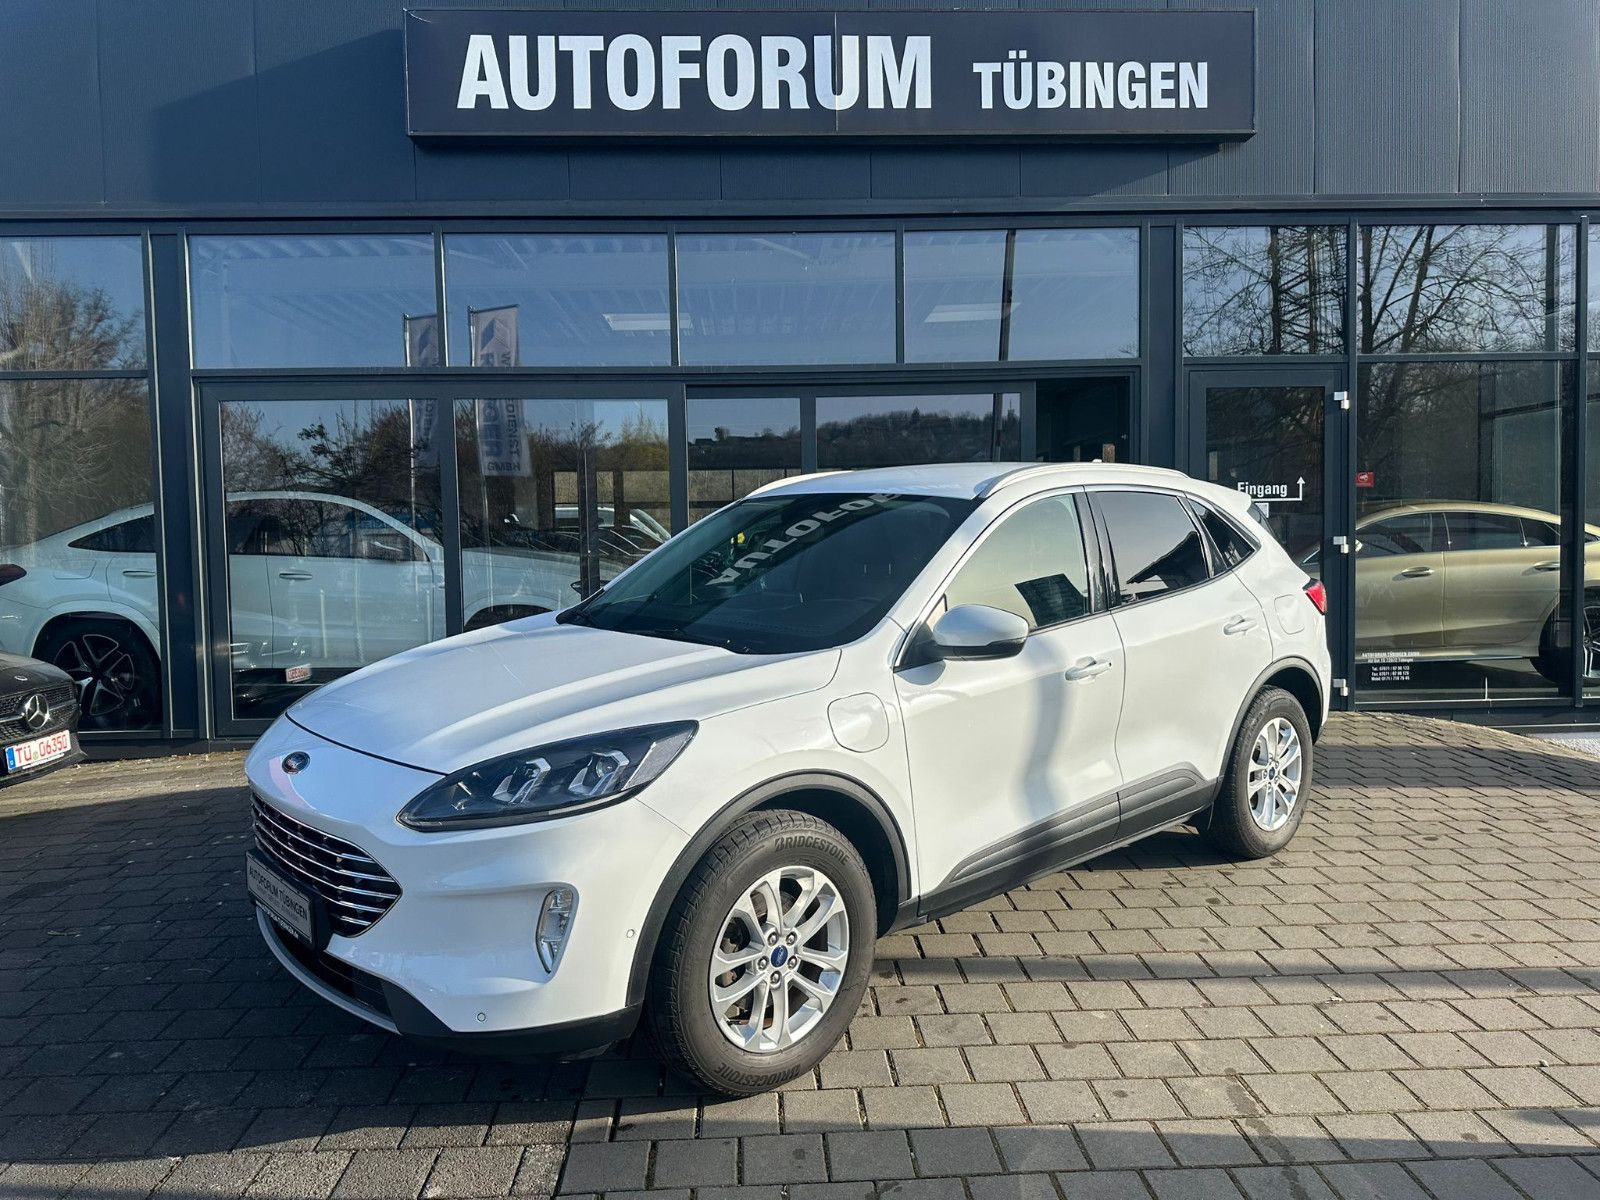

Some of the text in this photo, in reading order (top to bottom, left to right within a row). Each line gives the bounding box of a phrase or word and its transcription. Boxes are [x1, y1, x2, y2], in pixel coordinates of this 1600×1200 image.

[456, 33, 1208, 111] AUTOFORUM TÜBINGEN
[1237, 481, 1288, 498] Eingang
[15, 734, 68, 764] TÜ 06350
[774, 834, 850, 866] BRIDGESTONE
